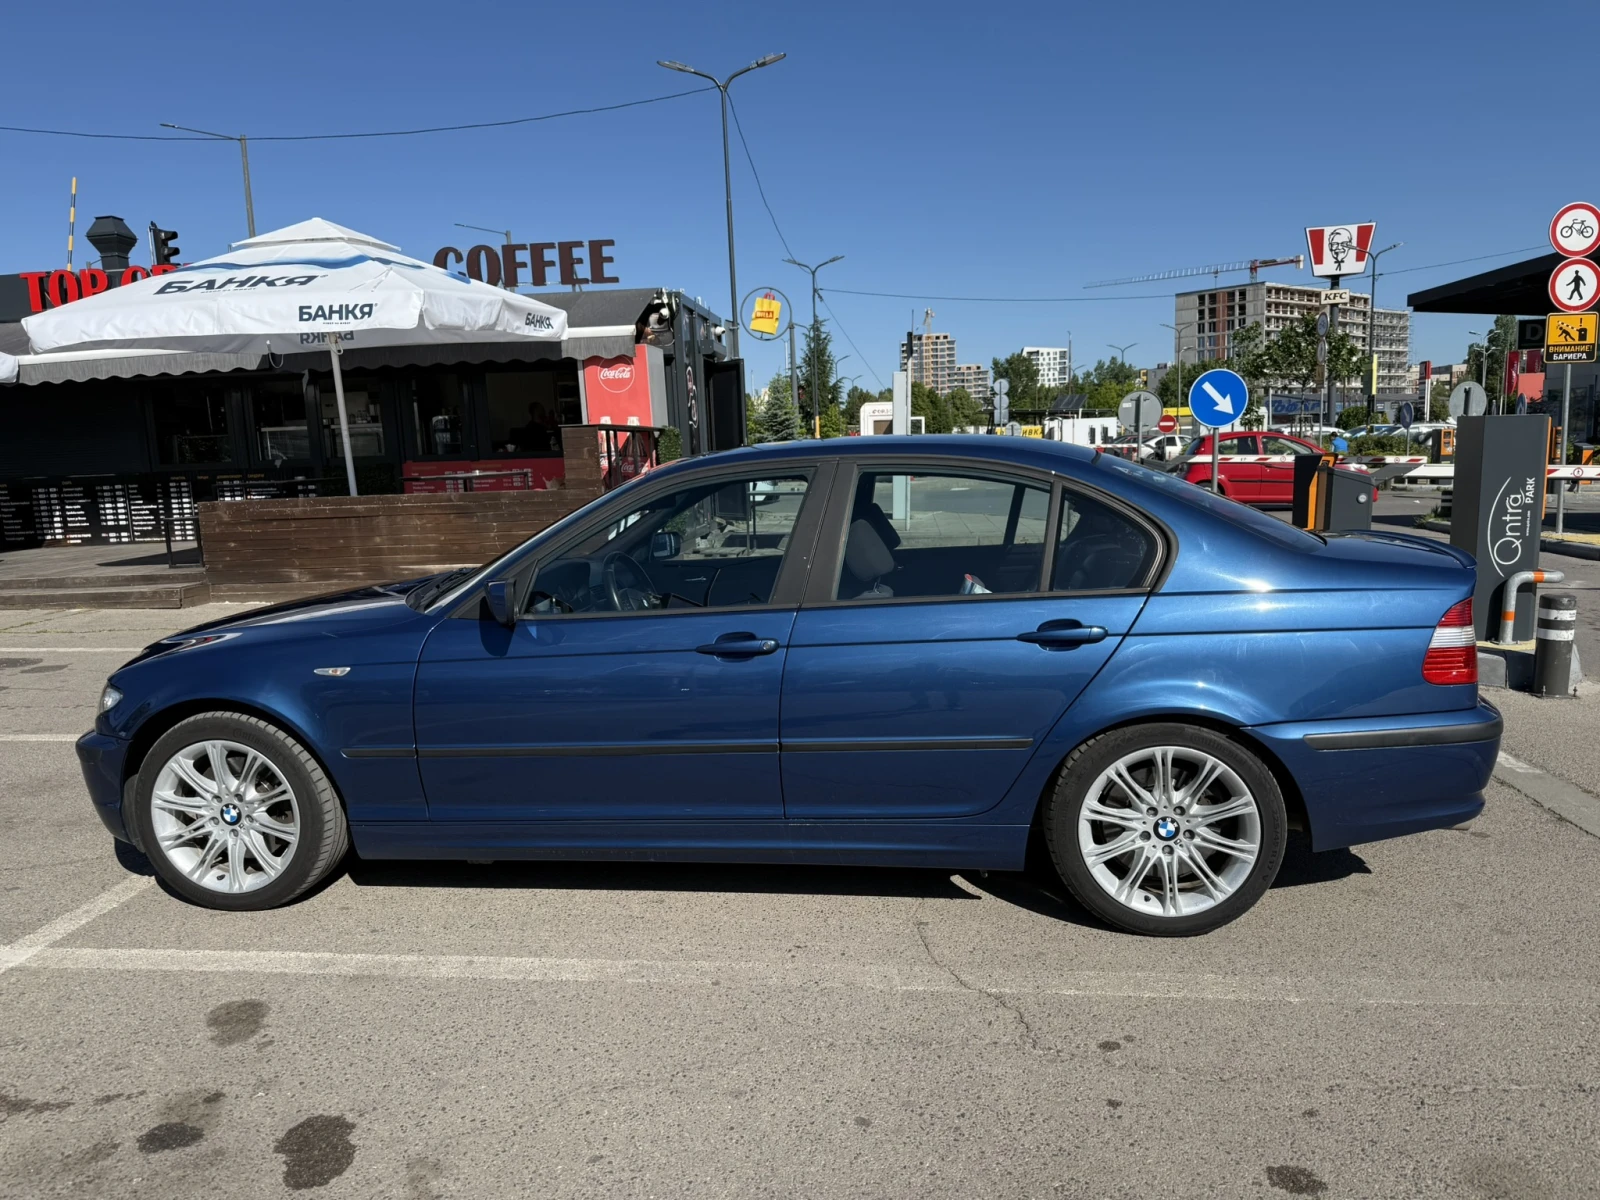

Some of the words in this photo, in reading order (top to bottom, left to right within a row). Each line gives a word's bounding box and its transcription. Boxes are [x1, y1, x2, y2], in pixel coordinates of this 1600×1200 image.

[433, 239, 619, 287] COFFEE
[20, 269, 108, 311] TOP
[153, 275, 319, 295] БАНКЯ
[1324, 292, 1347, 300] KFC
[298, 303, 373, 321] БАНКЯ
[525, 312, 554, 329] БАНКЯ
[1524, 477, 1536, 503] PARK
